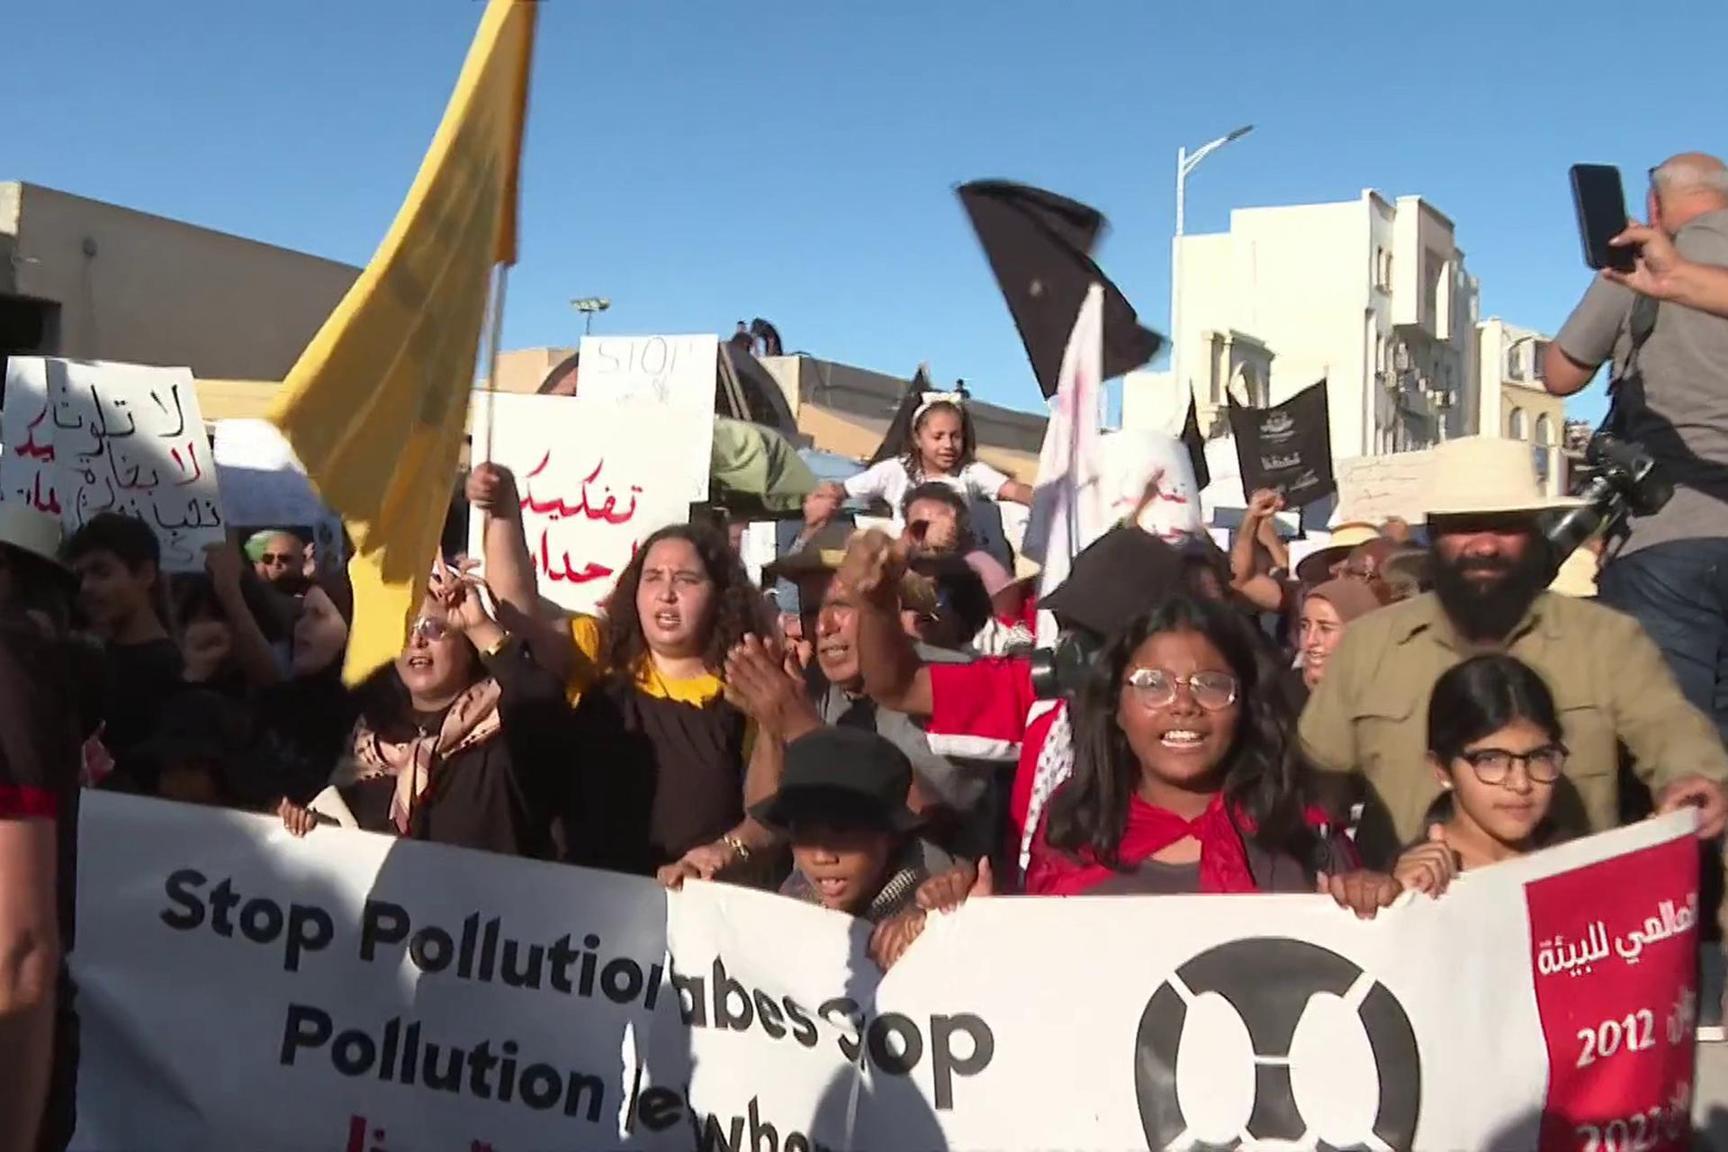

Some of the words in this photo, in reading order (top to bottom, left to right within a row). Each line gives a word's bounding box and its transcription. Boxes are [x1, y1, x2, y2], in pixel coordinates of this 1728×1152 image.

[150, 384, 184, 438] لا
[159, 868, 334, 972] Stop
[1538, 920, 1610, 978] للبيئة
[280, 1004, 605, 1122] Pollution
[1576, 1008, 1656, 1069] 2012
